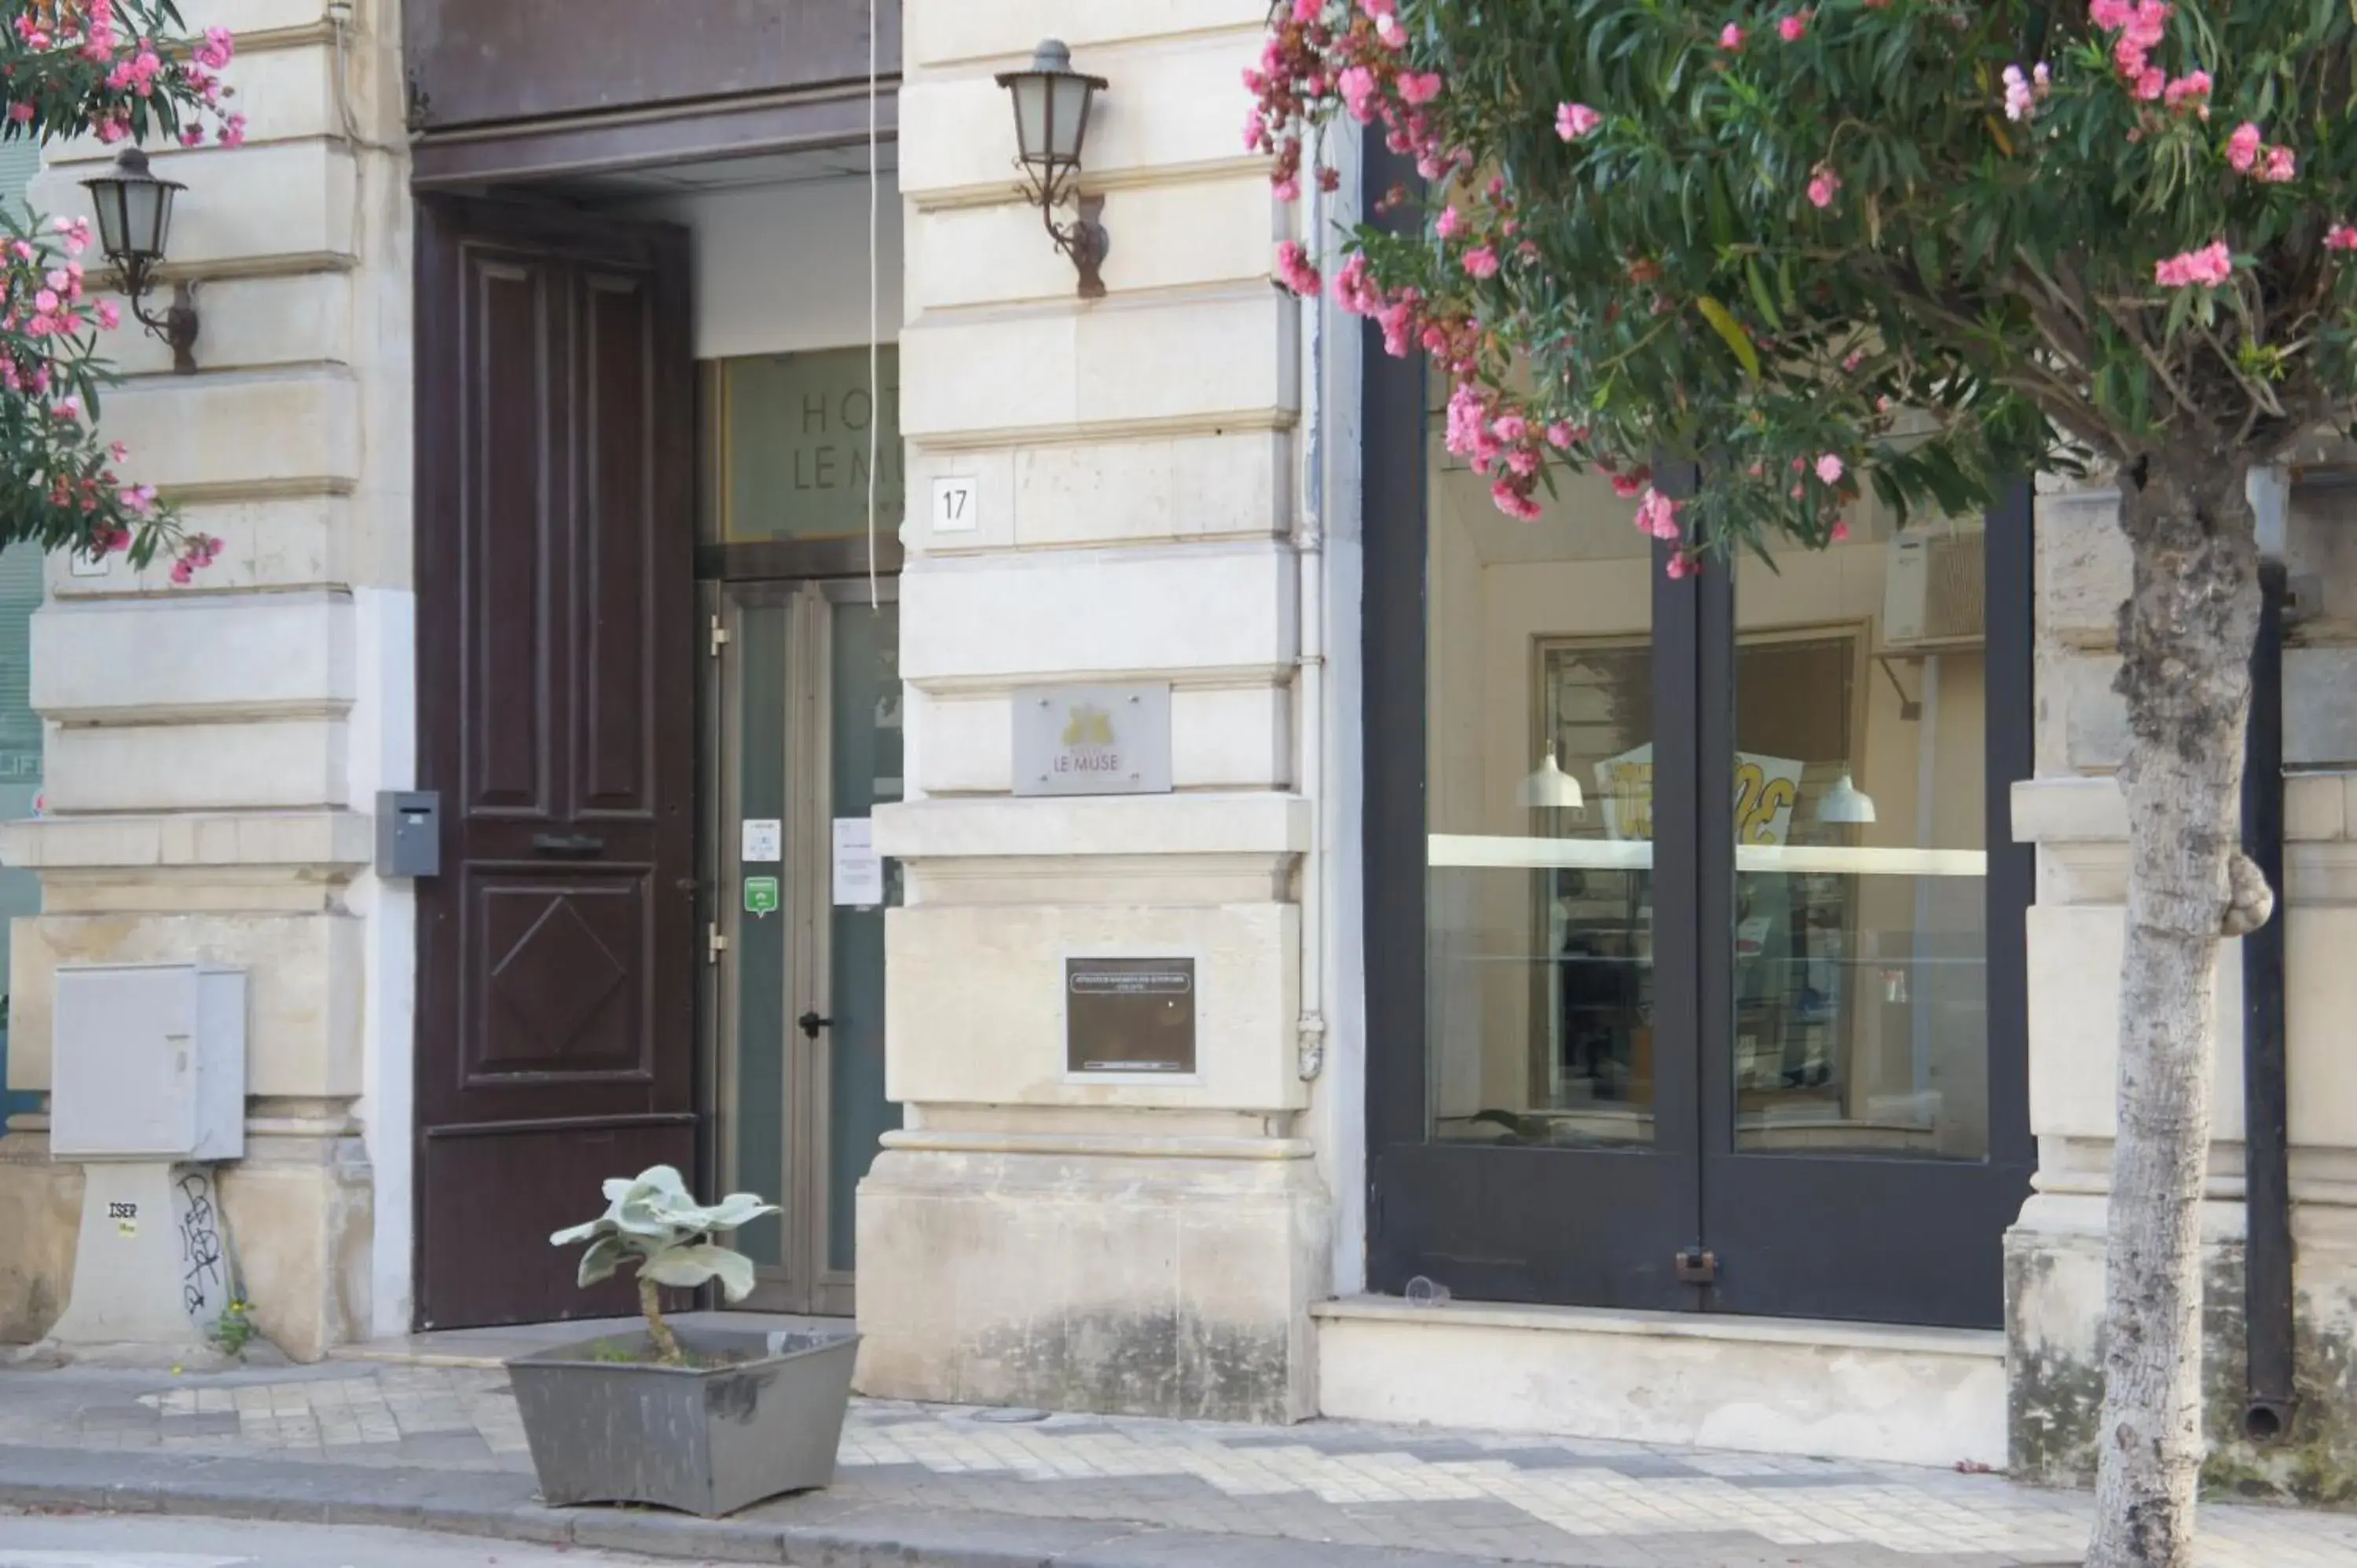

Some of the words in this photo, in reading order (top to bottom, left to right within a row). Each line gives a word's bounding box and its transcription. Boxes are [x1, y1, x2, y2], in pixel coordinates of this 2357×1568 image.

[943, 489, 968, 521] 17
[1054, 756, 1069, 773] LE
[1074, 754, 1119, 772] MUSE
